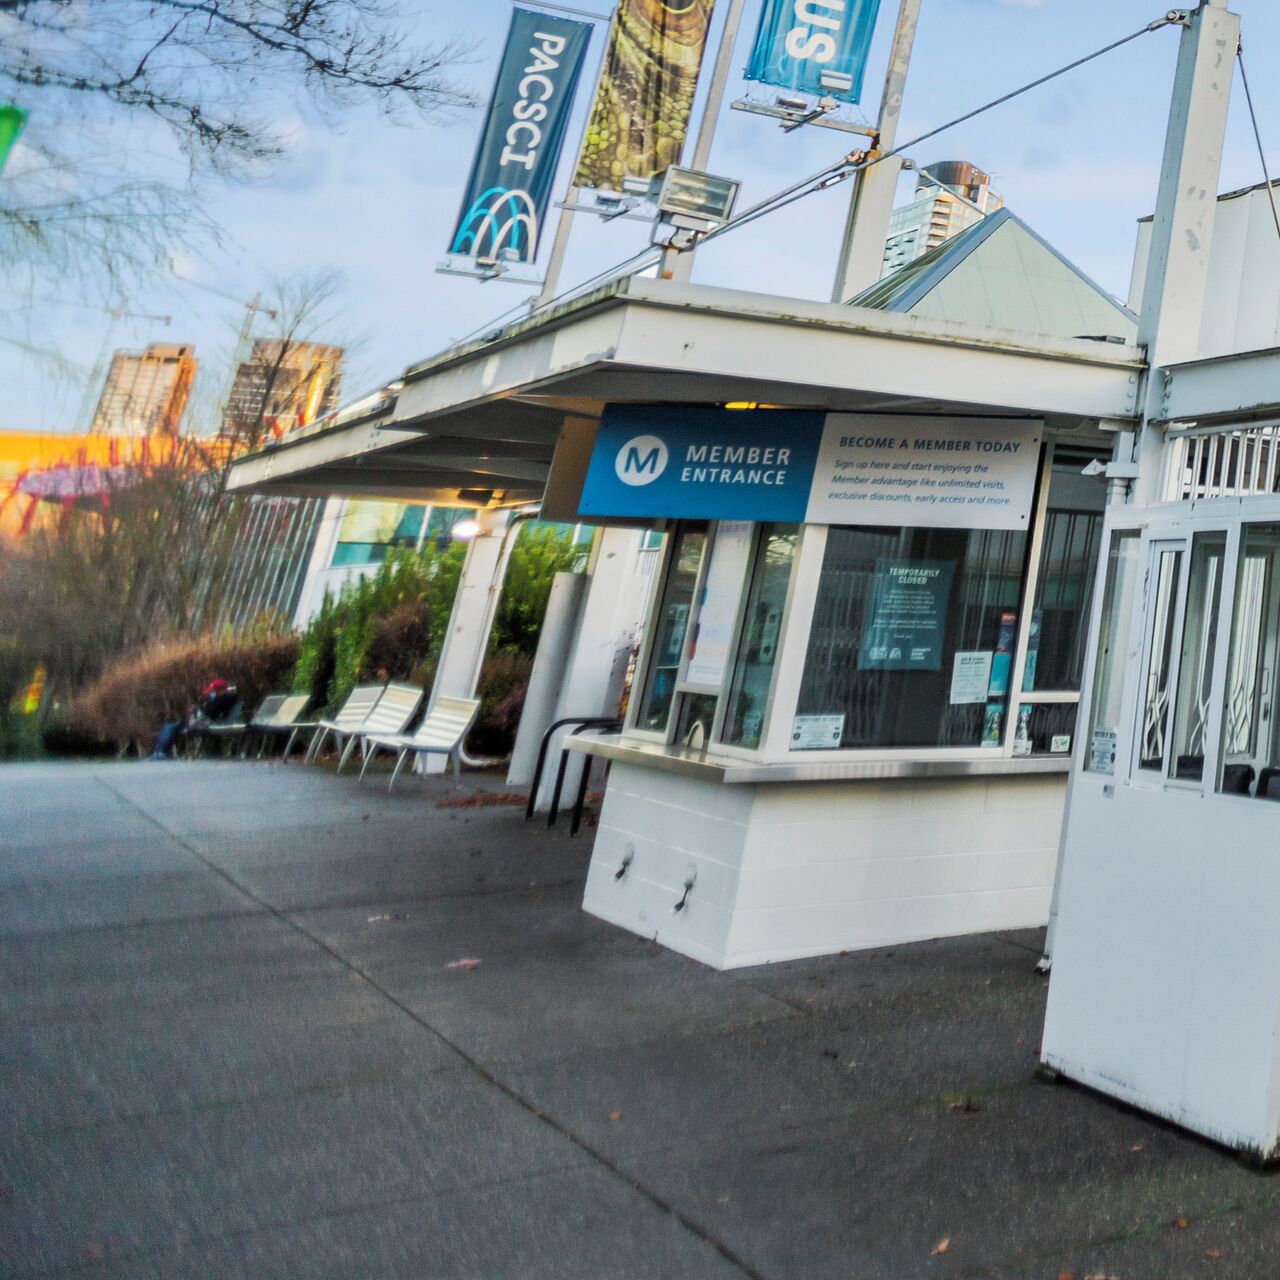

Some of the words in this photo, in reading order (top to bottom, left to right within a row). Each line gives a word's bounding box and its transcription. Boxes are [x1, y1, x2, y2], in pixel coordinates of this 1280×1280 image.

[500, 32, 566, 170] PACSCI
[839, 436, 895, 449] BECOME
[899, 438, 908, 450] A
[913, 439, 970, 451] MEMBER
[975, 441, 1021, 453] TODAY
[624, 447, 660, 473] M
[686, 445, 790, 465] MEMBER
[834, 459, 854, 470] Sign
[856, 461, 867, 471] up
[869, 460, 890, 470] here
[892, 461, 909, 471] and
[911, 462, 931, 471] start
[933, 463, 971, 474] enjoying
[974, 464, 989, 473] the
[680, 467, 786, 485] ENTRANCE
[831, 475, 869, 485] Member
[871, 476, 918, 488] advantage
[919, 476, 936, 487] like
[938, 478, 981, 489] unlimited
[982, 480, 1005, 490] visits,
[828, 491, 867, 501] exclusive
[869, 492, 912, 503] discounts,
[915, 494, 937, 504] early
[939, 495, 965, 504] access
[967, 494, 984, 504] and
[889, 568, 940, 577] TEMPORARILY
[898, 576, 928, 585] CLOSED
